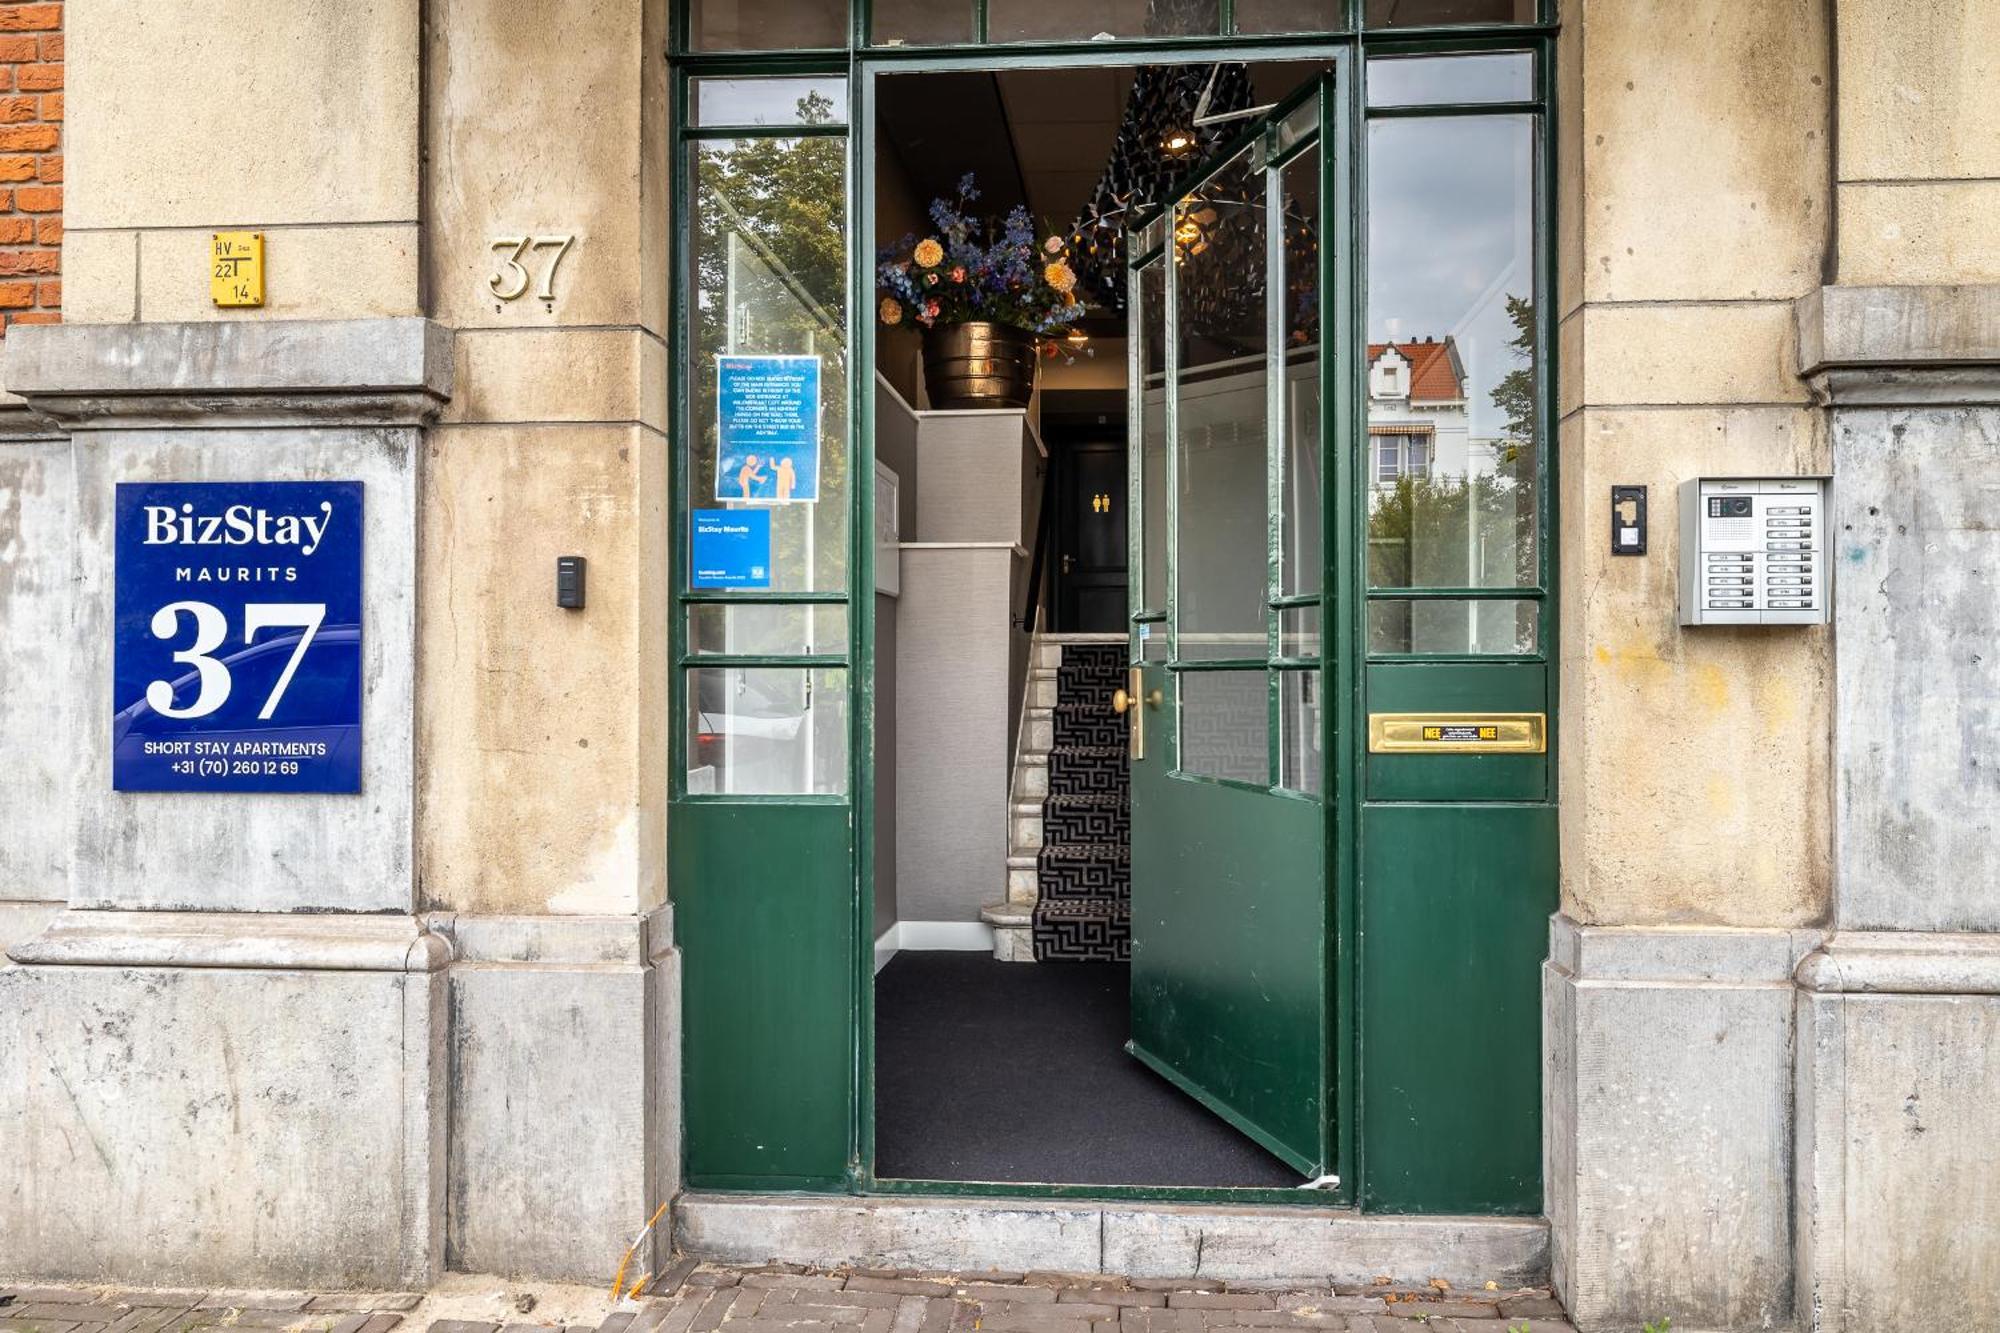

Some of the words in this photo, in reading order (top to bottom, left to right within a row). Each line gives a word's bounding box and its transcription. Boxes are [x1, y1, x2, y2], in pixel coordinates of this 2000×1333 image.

[215, 242, 232, 255] HV
[488, 235, 576, 301] 37
[143, 501, 332, 556] BizStay
[175, 567, 298, 582] MAURITS
[146, 600, 327, 720] 37
[1424, 727, 1441, 739] NEE
[1479, 727, 1496, 739] NEE
[144, 742, 191, 755] SHORT
[194, 742, 231, 755] STAY
[233, 742, 326, 756] APARTMENTS
[171, 761, 195, 774] +31
[199, 760, 229, 777] (70)
[233, 761, 260, 775] 260
[263, 761, 277, 774] 12
[280, 761, 299, 774] 69
